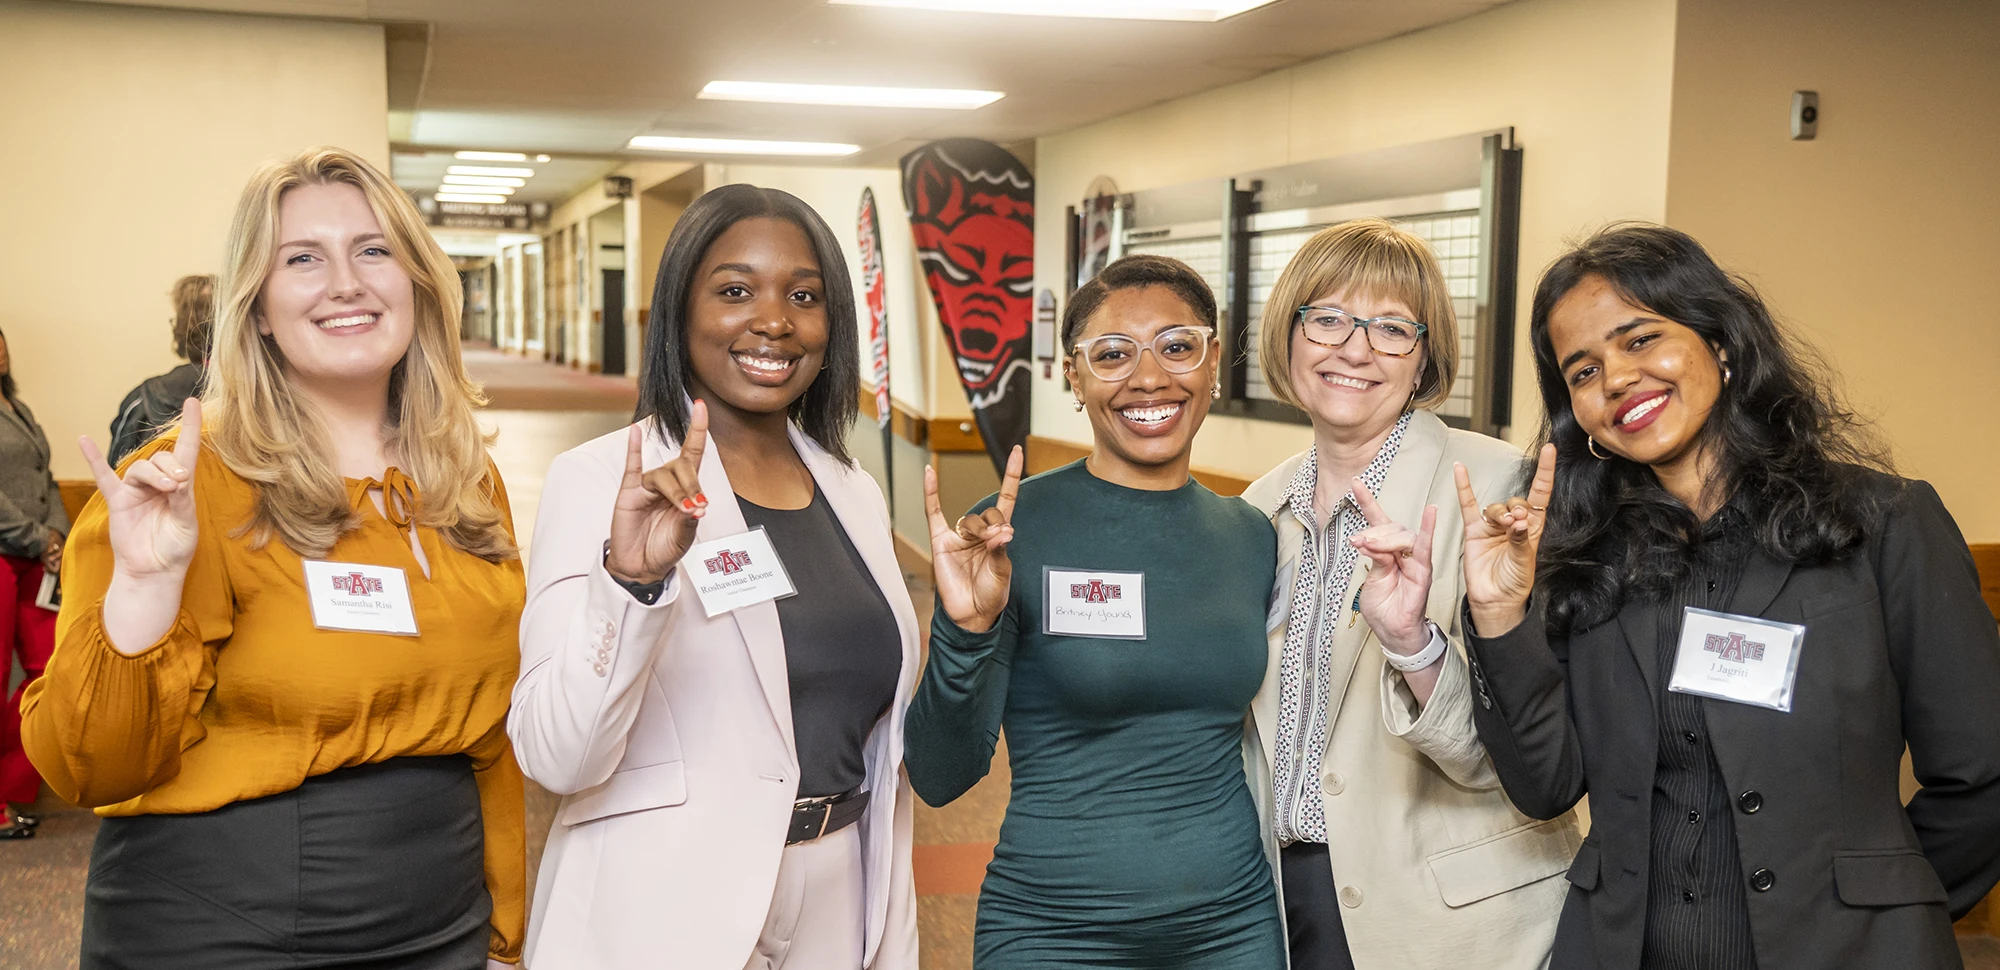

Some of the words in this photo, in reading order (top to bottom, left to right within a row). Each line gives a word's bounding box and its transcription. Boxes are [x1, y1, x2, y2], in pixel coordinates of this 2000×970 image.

[703, 549, 752, 575] STATE
[332, 572, 383, 596] STATE
[748, 570, 773, 582] Boone
[1071, 579, 1121, 603] STATE
[330, 598, 373, 609] Samantha
[1056, 606, 1092, 620] Britney
[1704, 632, 1766, 663] STATE
[1710, 663, 1716, 672] J
[1717, 664, 1748, 678] Jagriti
